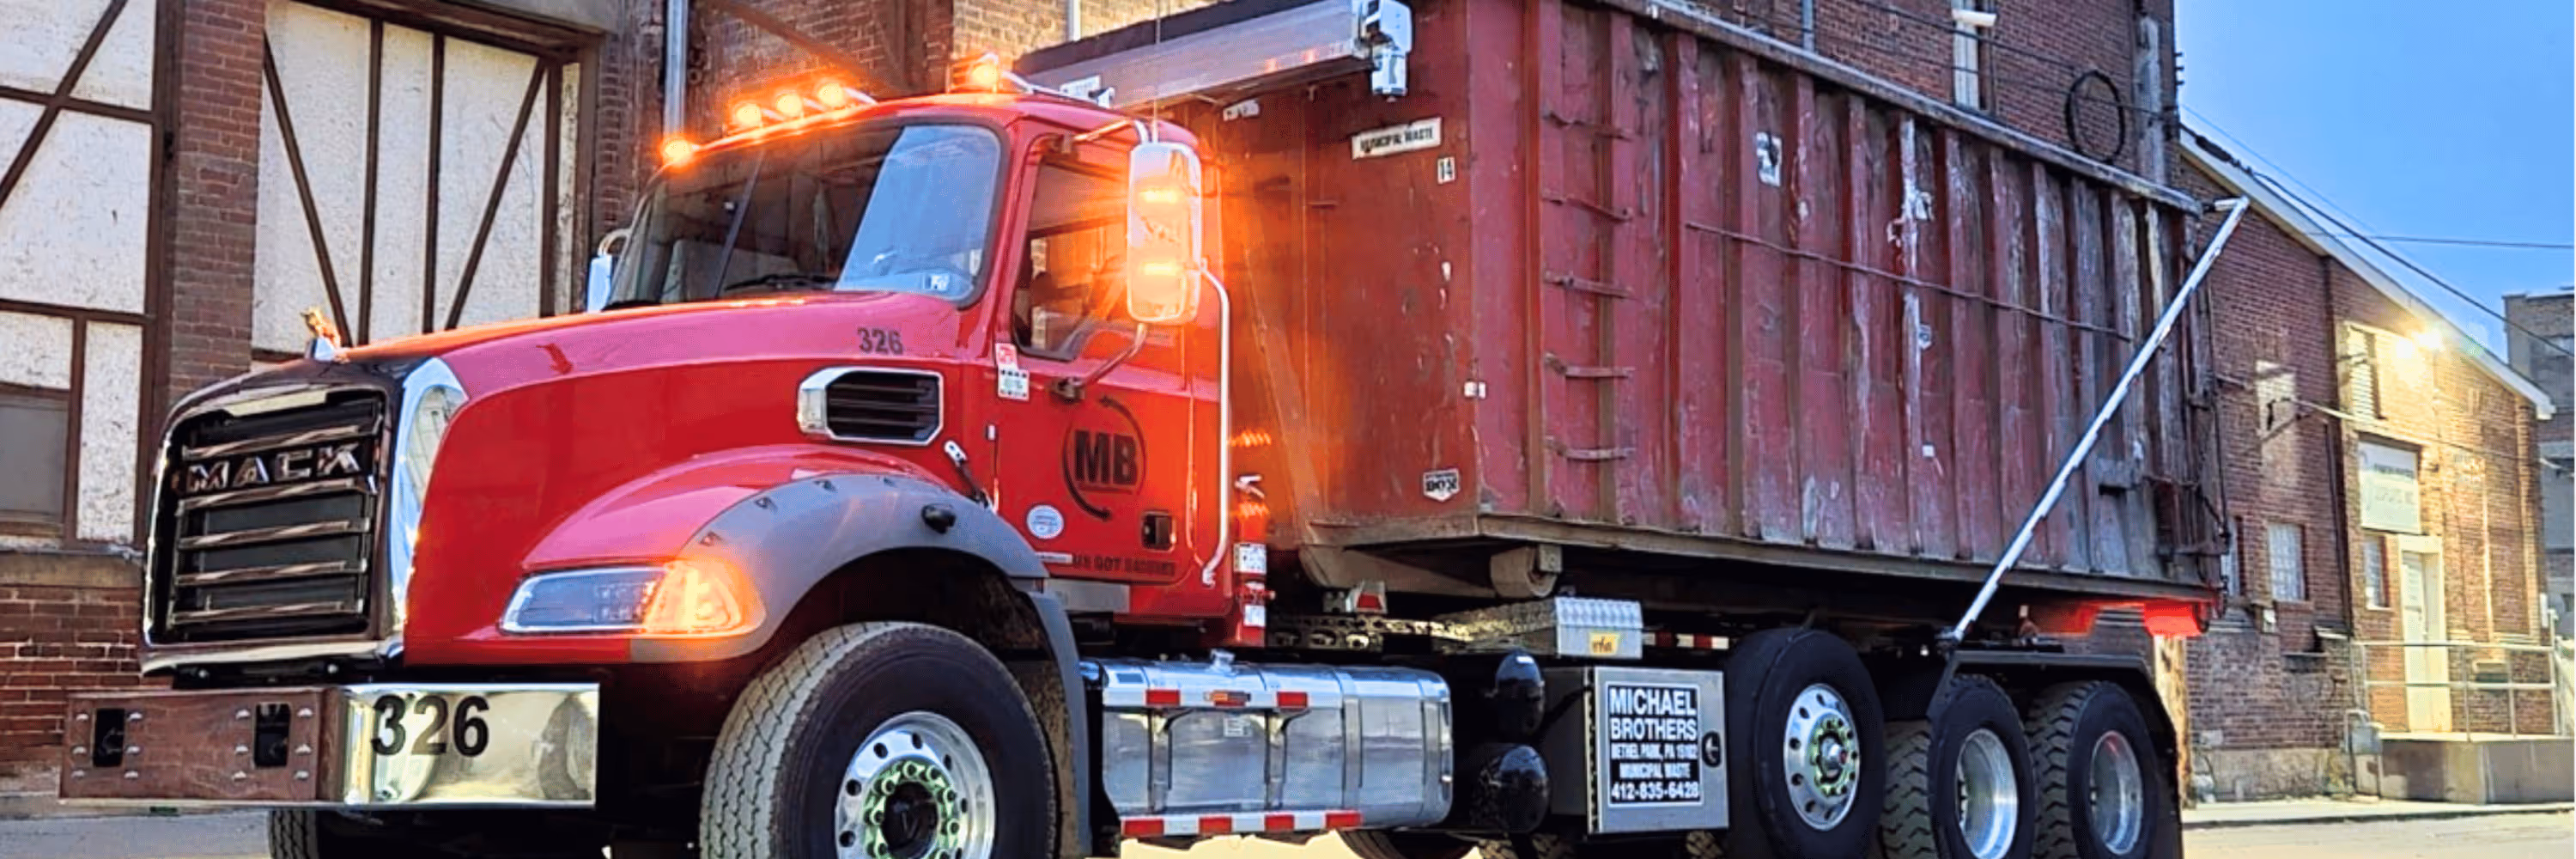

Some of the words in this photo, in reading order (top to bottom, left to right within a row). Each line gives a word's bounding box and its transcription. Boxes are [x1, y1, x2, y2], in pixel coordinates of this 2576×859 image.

[1439, 158, 1453, 180] 14
[857, 327, 903, 355] 326
[186, 442, 360, 493] MACK
[1074, 430, 1138, 486] MB
[1609, 688, 1697, 716] MICHAEL
[371, 693, 489, 758] 326
[1611, 717, 1697, 741] BROTHERS
[1611, 742, 1638, 759] BETHEL
[1611, 781, 1699, 800] 412-835-6428
